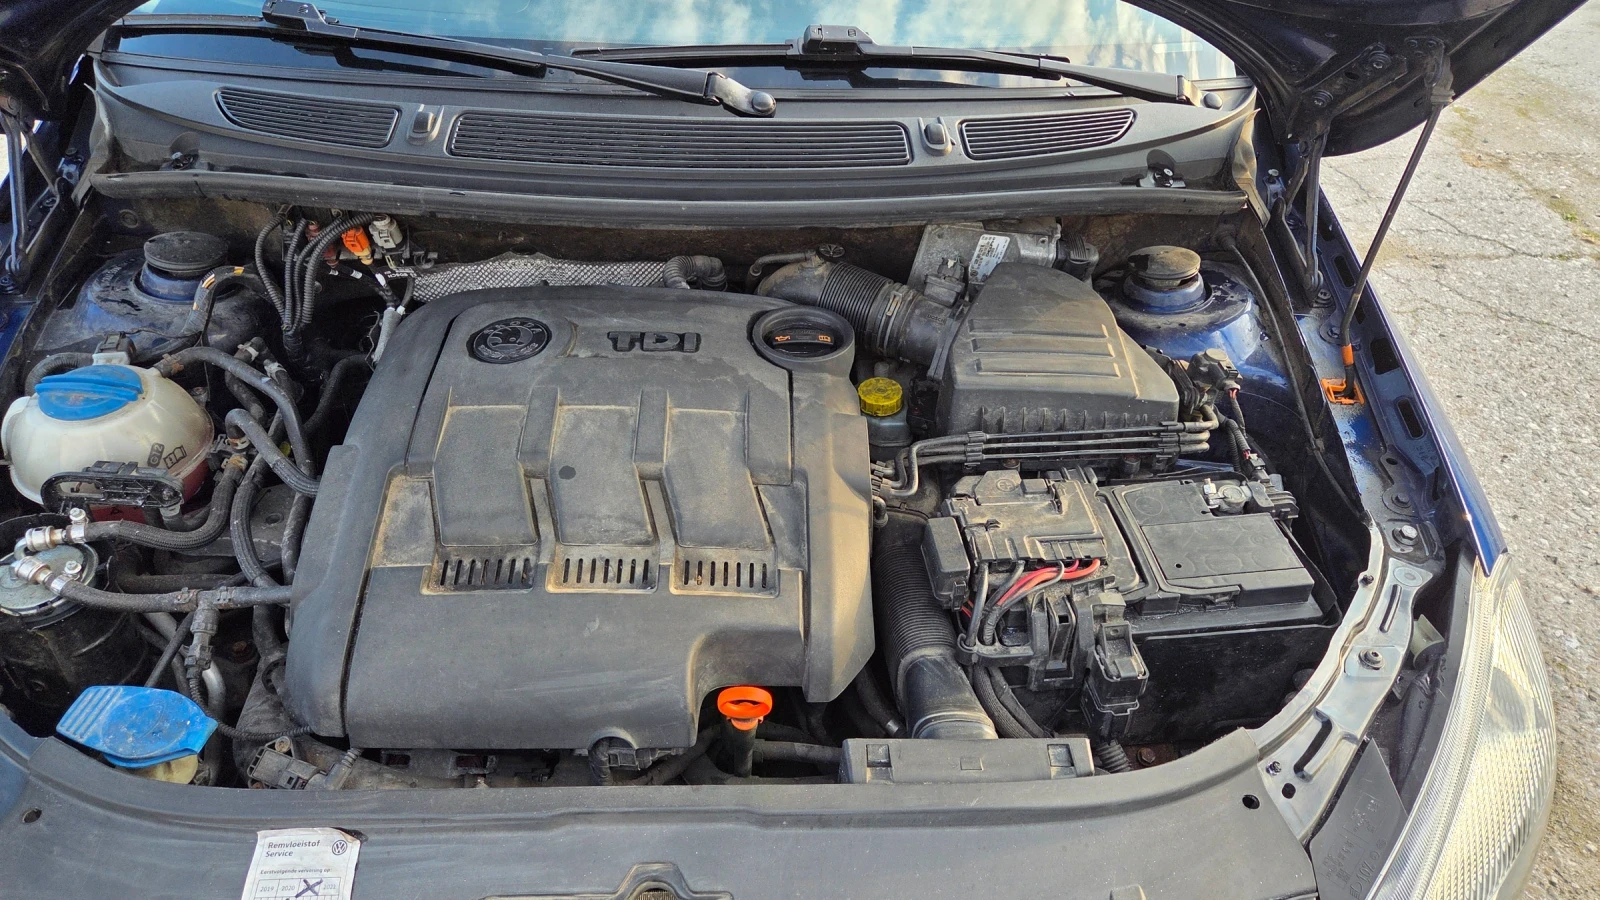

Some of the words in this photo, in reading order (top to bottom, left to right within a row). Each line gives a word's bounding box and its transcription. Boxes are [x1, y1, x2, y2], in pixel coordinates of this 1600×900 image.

[608, 331, 699, 352] TDI
[150, 445, 163, 464] G12
[267, 840, 321, 849] Remvloeistof
[265, 850, 294, 858] Service
